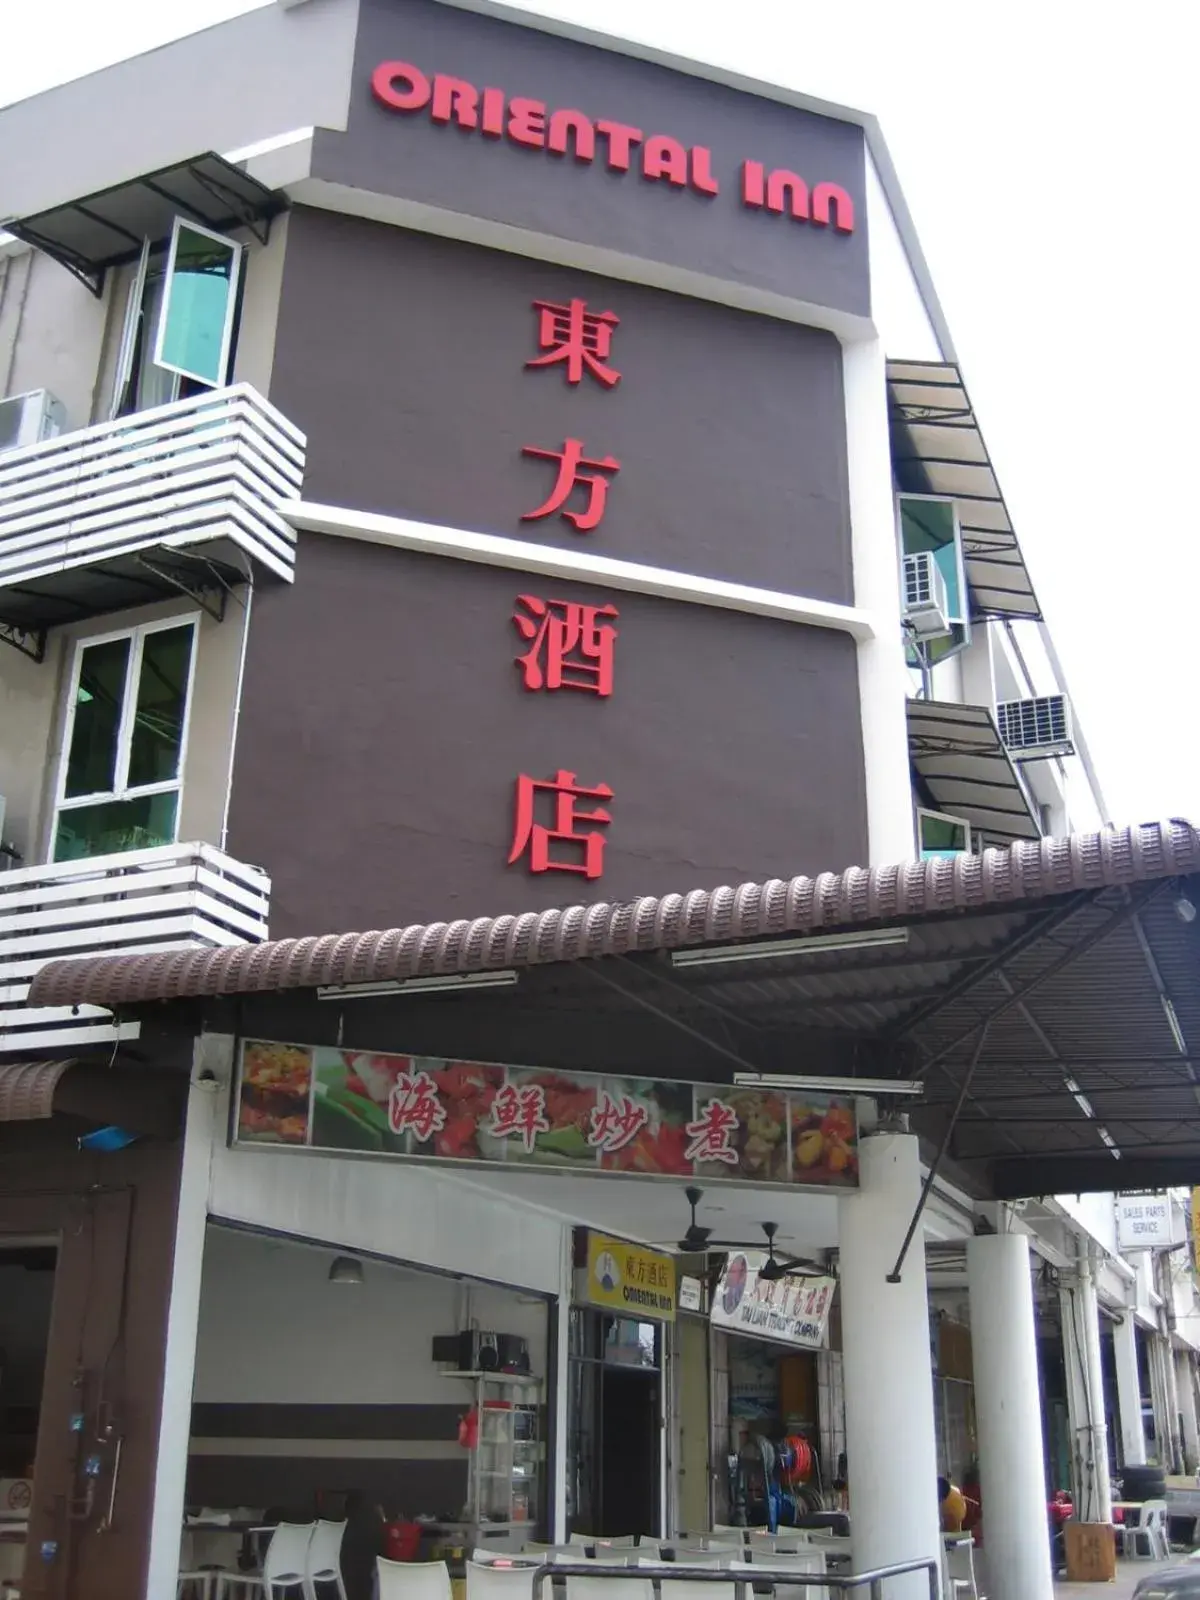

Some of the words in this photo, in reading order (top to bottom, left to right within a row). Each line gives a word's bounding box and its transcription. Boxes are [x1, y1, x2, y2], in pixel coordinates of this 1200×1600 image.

[371, 61, 719, 197] ORIENTAL
[742, 159, 856, 235] INN
[508, 297, 622, 880] 東方酒店
[389, 1072, 739, 1165] 海鮮炒煮
[1132, 1222, 1159, 1234] SERVICE
[1145, 1204, 1165, 1218] PARTS
